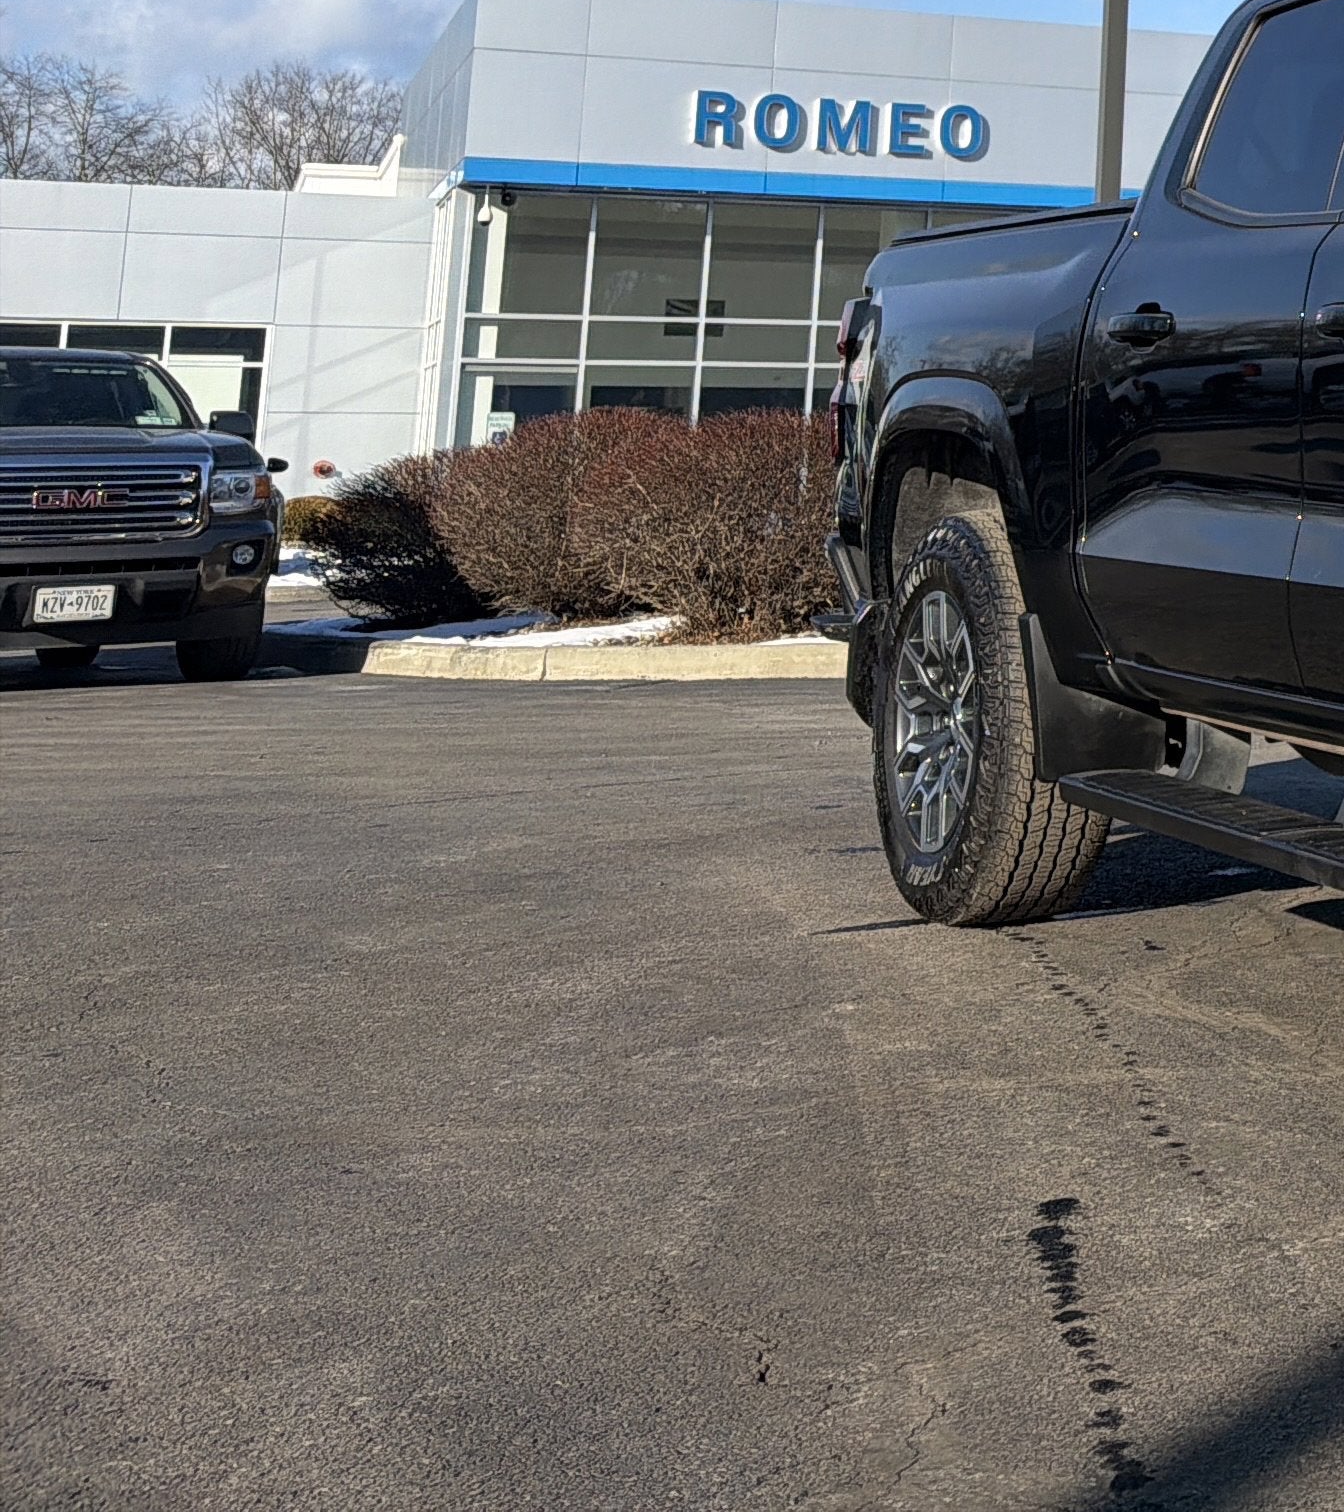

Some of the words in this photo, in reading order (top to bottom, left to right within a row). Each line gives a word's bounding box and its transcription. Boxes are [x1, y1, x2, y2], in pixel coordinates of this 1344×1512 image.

[693, 90, 986, 160] ROMEO
[32, 489, 130, 509] GMC
[41, 597, 67, 614] KZV
[75, 595, 108, 612] 9702
